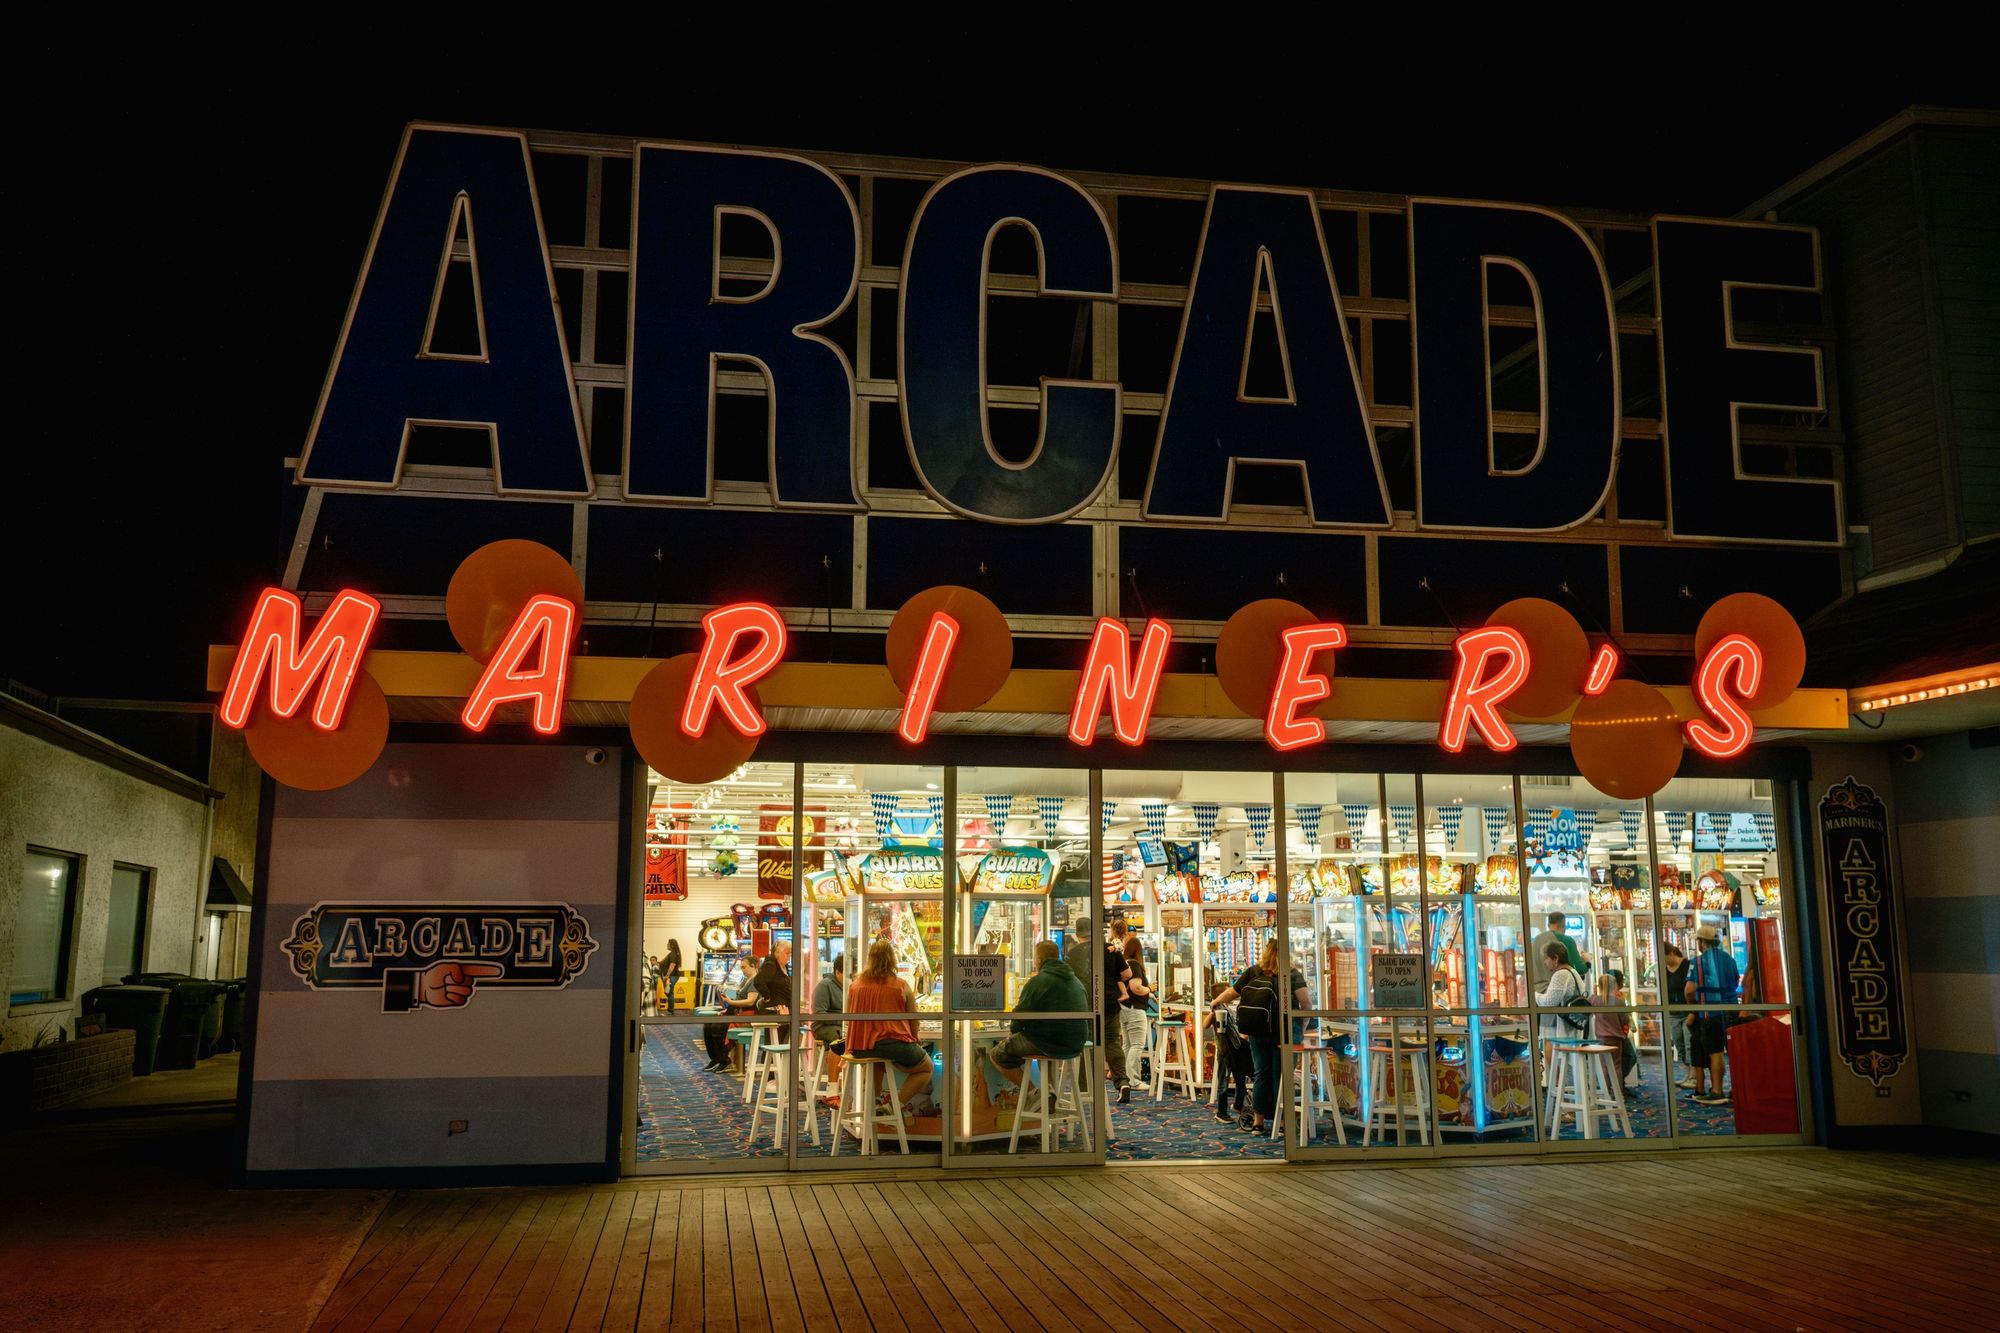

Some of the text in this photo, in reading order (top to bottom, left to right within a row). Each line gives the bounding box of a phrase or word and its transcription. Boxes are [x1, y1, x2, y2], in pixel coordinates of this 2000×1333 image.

[294, 120, 1848, 549] ARCADE
[219, 586, 1764, 758] MARINER'S
[1547, 818, 1580, 832] NOW
[1545, 832, 1577, 847] DAY!
[869, 855, 944, 873] QUARRY
[985, 855, 1048, 874] QUARRY
[648, 873, 662, 884] TIE
[903, 873, 944, 889] QUES
[1004, 873, 1045, 890] QUEST
[645, 884, 680, 895] GHTER
[329, 916, 556, 968] ARCADE
[1839, 838, 1891, 1041] ARCADE
[957, 958, 999, 968] SLIDE DOOR
[1378, 957, 1417, 967] SLIDE DOOR
[963, 968, 993, 977] TO OPEN
[1384, 966, 1412, 976] TO OPEN
[961, 979, 996, 990] Be Cool
[1379, 977, 1418, 989] Stay Cool
